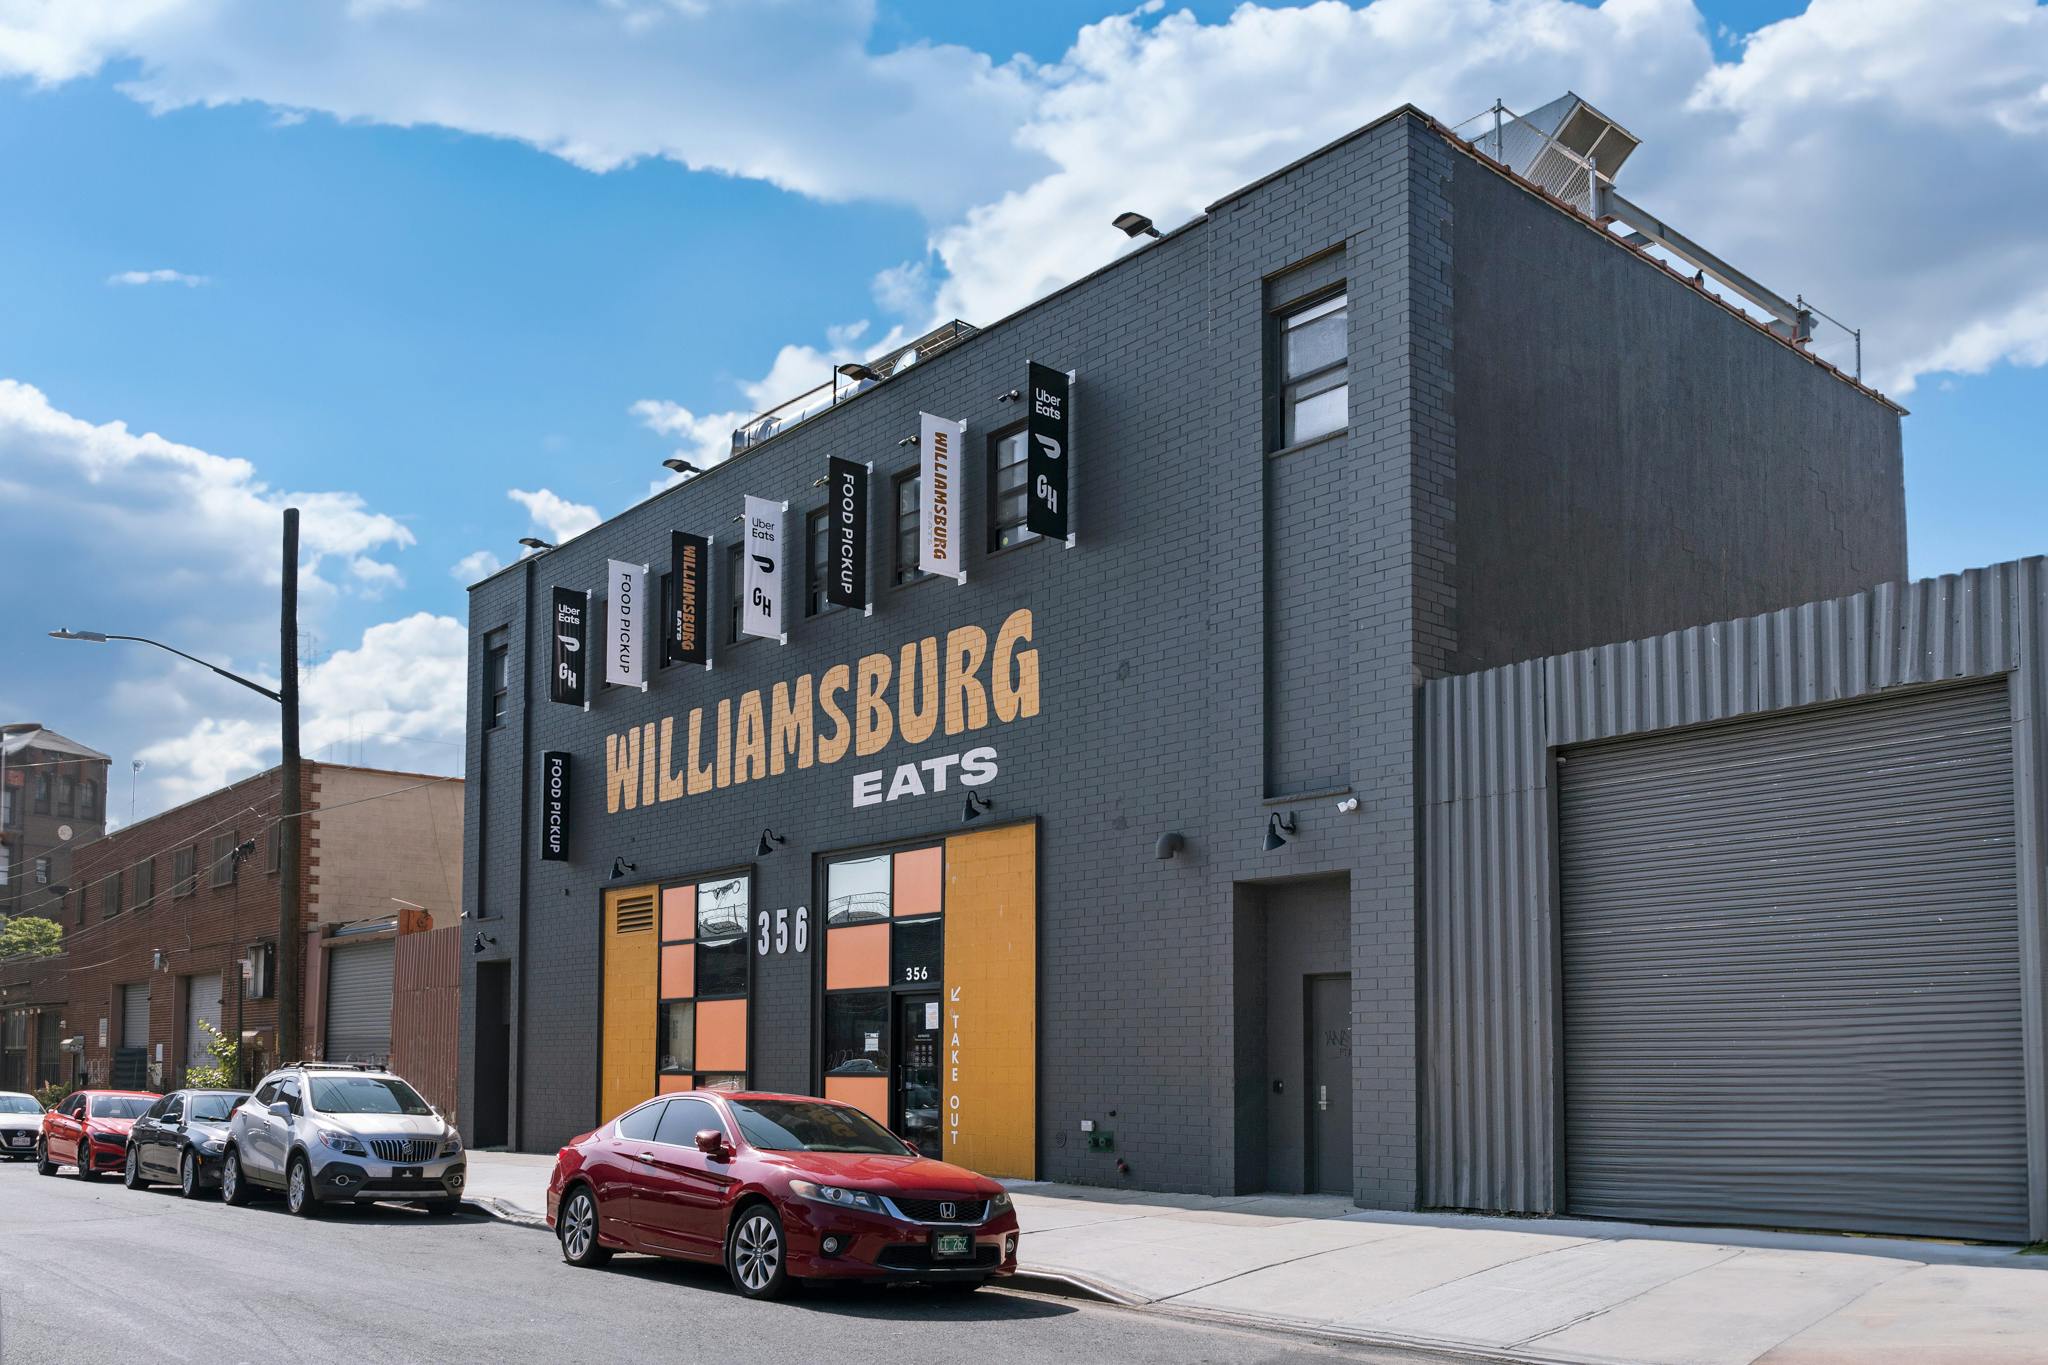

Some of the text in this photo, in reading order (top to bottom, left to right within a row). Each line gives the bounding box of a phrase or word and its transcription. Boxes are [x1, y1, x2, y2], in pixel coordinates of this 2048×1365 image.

[1035, 387, 1061, 407] Uber
[1035, 401, 1061, 420] Eats
[933, 431, 948, 560] WILLIAMSBURG
[1036, 474, 1058, 514] GH
[752, 517, 775, 531] Uber
[752, 528, 775, 541] Eats
[840, 473, 855, 594] FOOD PICKUP
[558, 603, 581, 616] Uber
[681, 545, 696, 651] WILLIAMSBURG
[753, 587, 772, 618] GH
[558, 613, 580, 625] Eats
[619, 573, 632, 674] FOOD PICKUP
[558, 662, 577, 690] GH
[605, 608, 1040, 814] WILLIAMSBURG
[852, 746, 999, 807] EATS
[549, 758, 562, 853] FOOD PICKUP
[757, 906, 808, 956] 356
[905, 966, 928, 981] 356
[950, 1015, 960, 1145] TAKE OUT
